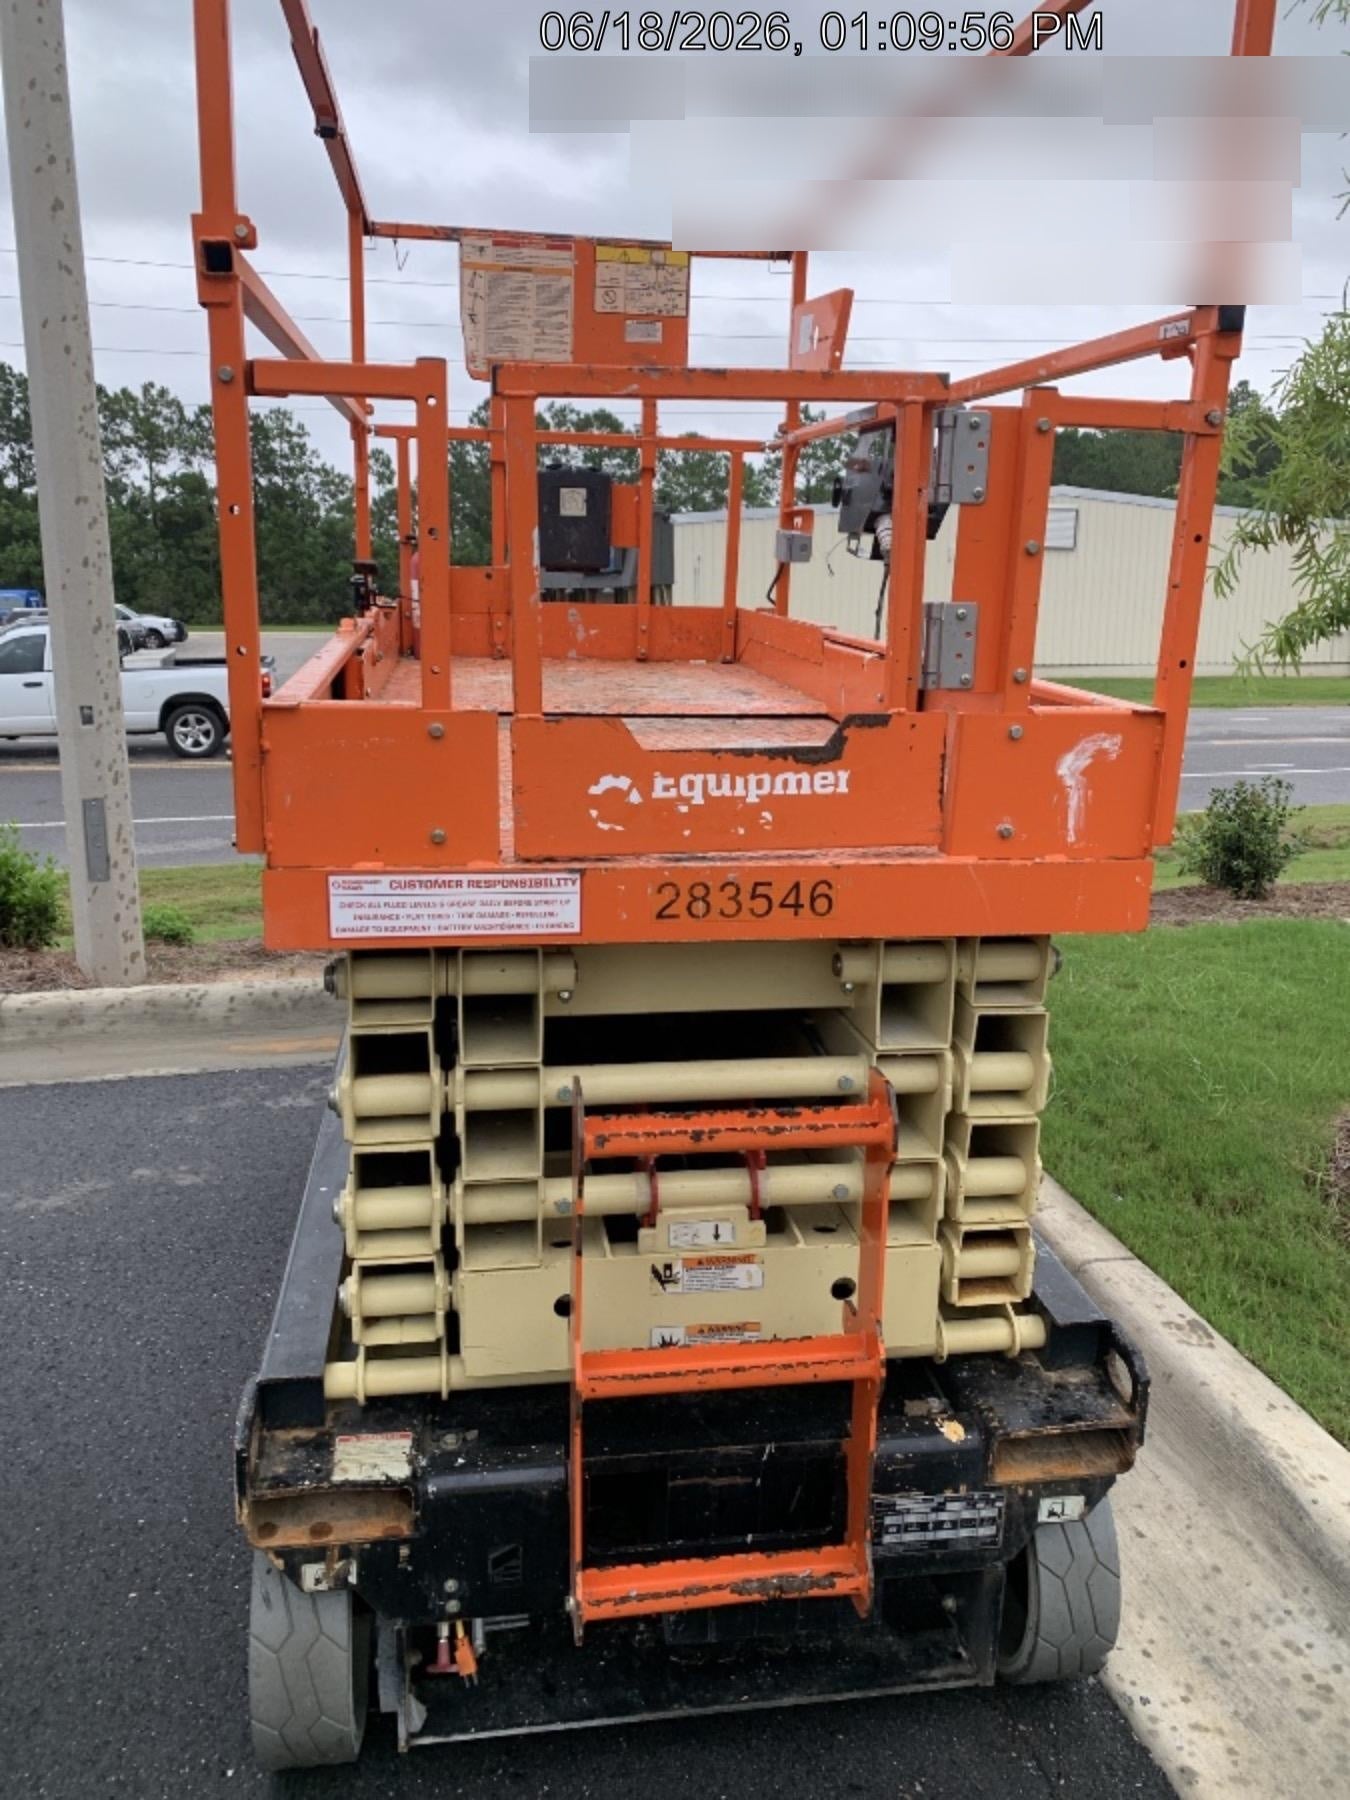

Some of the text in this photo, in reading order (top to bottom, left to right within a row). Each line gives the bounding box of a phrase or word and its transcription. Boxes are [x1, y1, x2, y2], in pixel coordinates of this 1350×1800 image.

[389, 878, 464, 891] CUSTOMER
[467, 877, 578, 890] RESPONSIBILITY
[655, 880, 834, 920] 283546
